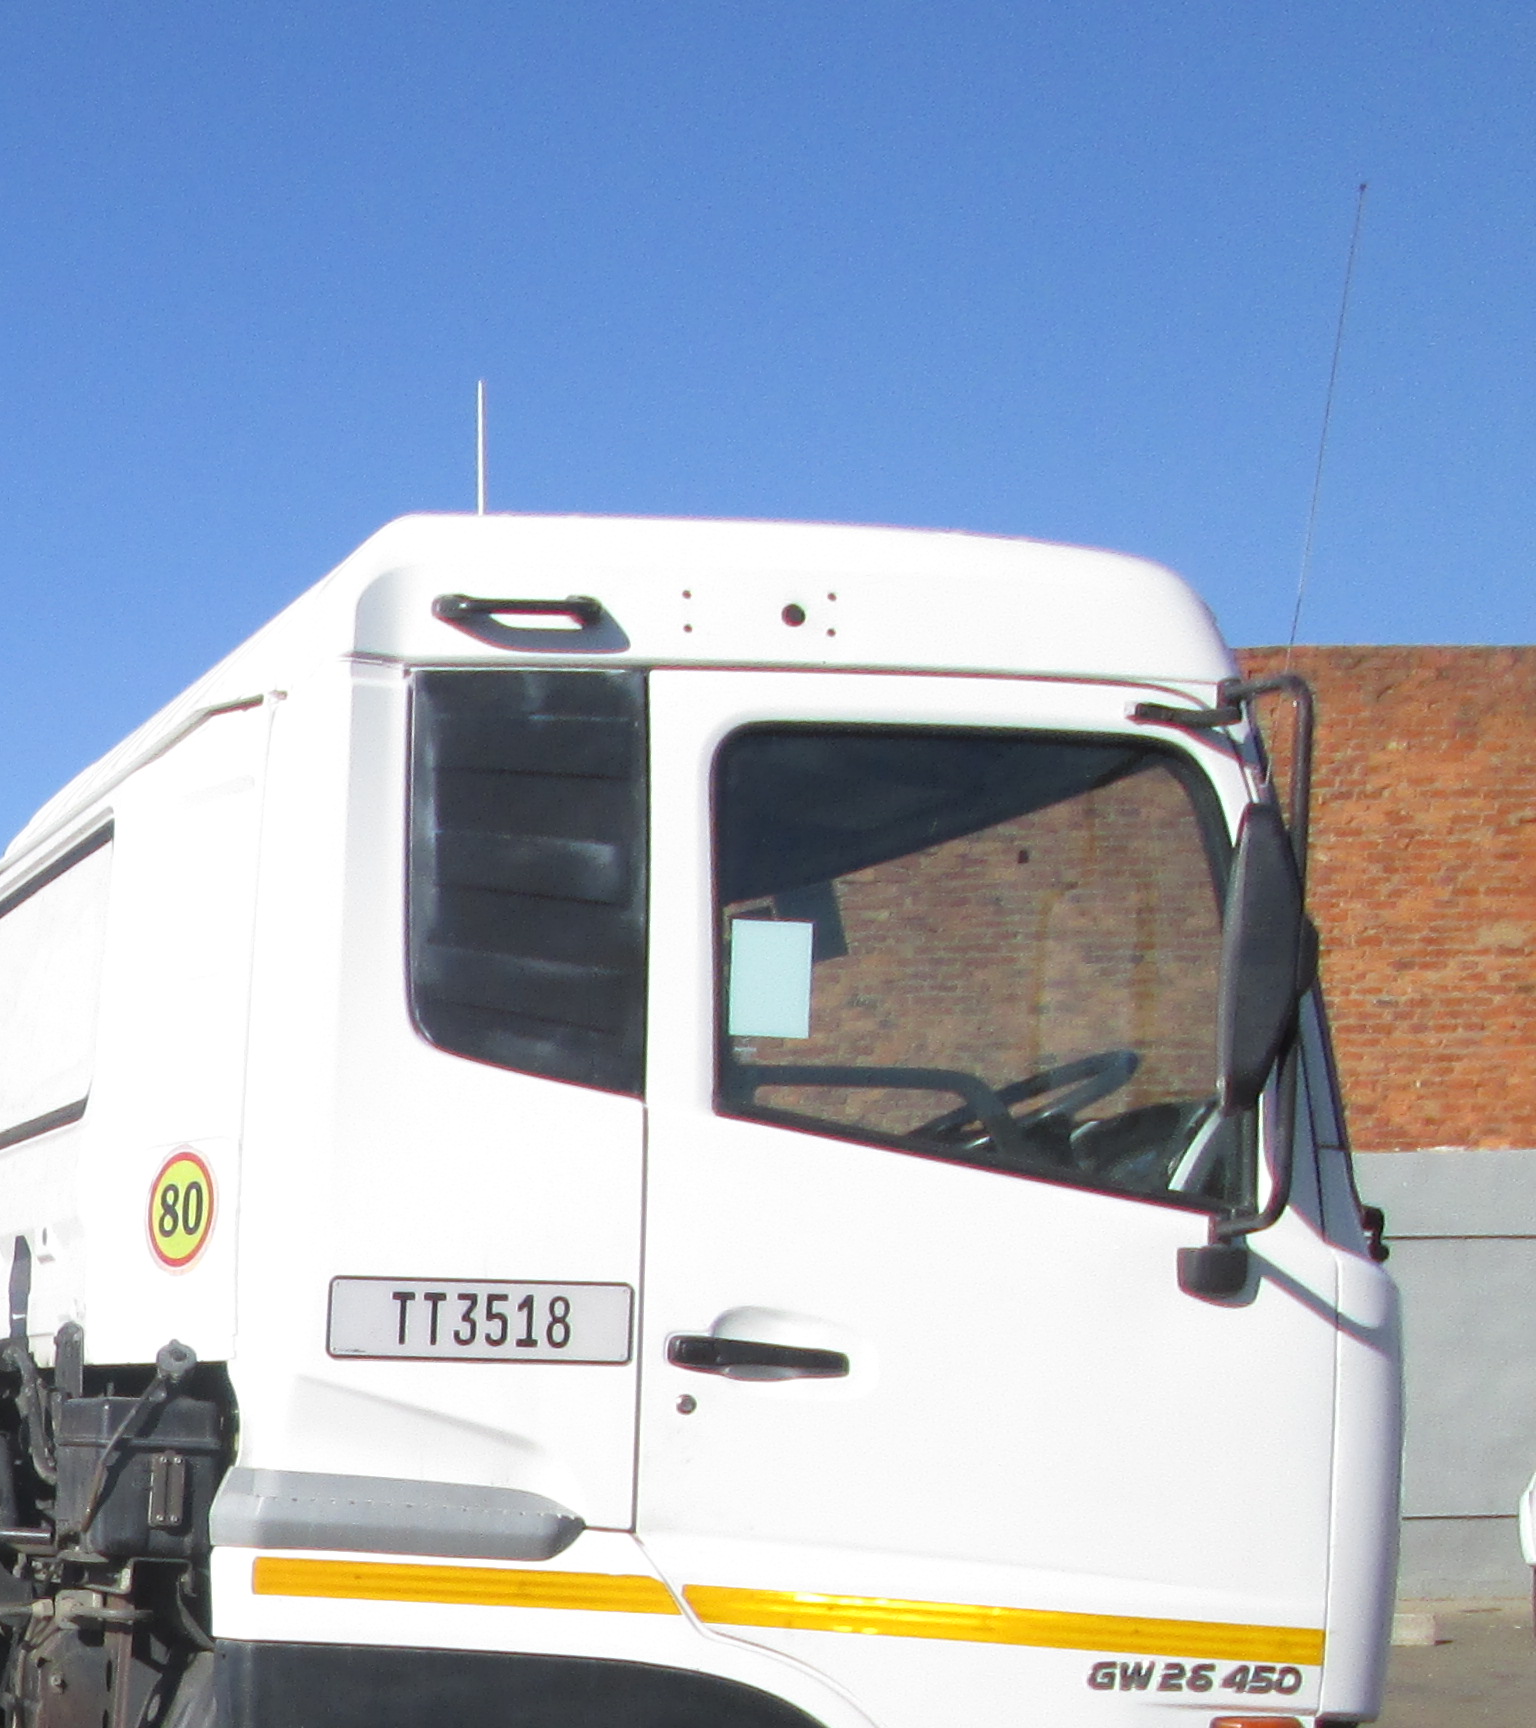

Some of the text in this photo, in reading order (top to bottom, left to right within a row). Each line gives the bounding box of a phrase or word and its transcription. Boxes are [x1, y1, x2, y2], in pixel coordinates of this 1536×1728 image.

[158, 1181, 204, 1238] 80
[391, 1291, 572, 1349] TT3518
[1087, 1661, 1303, 1696] GW 26 450
